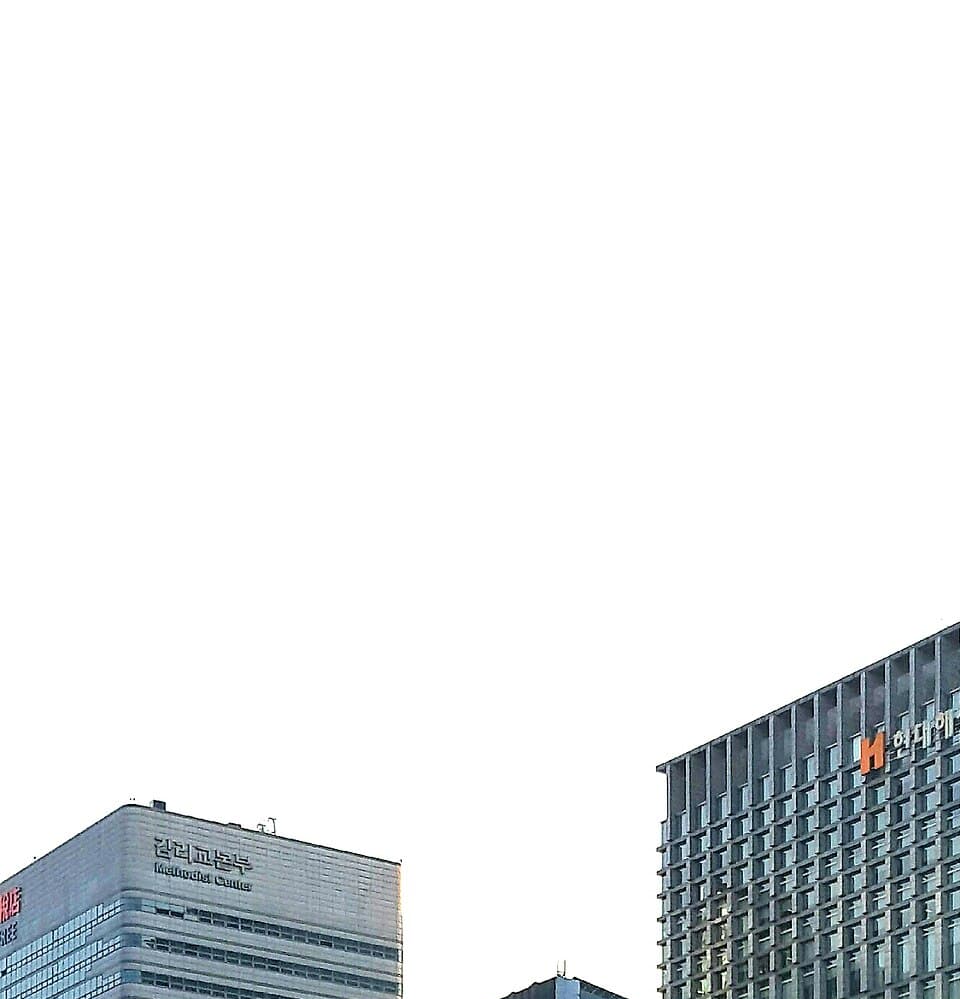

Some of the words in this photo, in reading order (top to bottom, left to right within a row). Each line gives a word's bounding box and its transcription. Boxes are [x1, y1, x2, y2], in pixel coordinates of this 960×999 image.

[154, 836, 253, 875] 감리교본부
[154, 862, 211, 885] Methodist
[214, 875, 253, 892] Center
